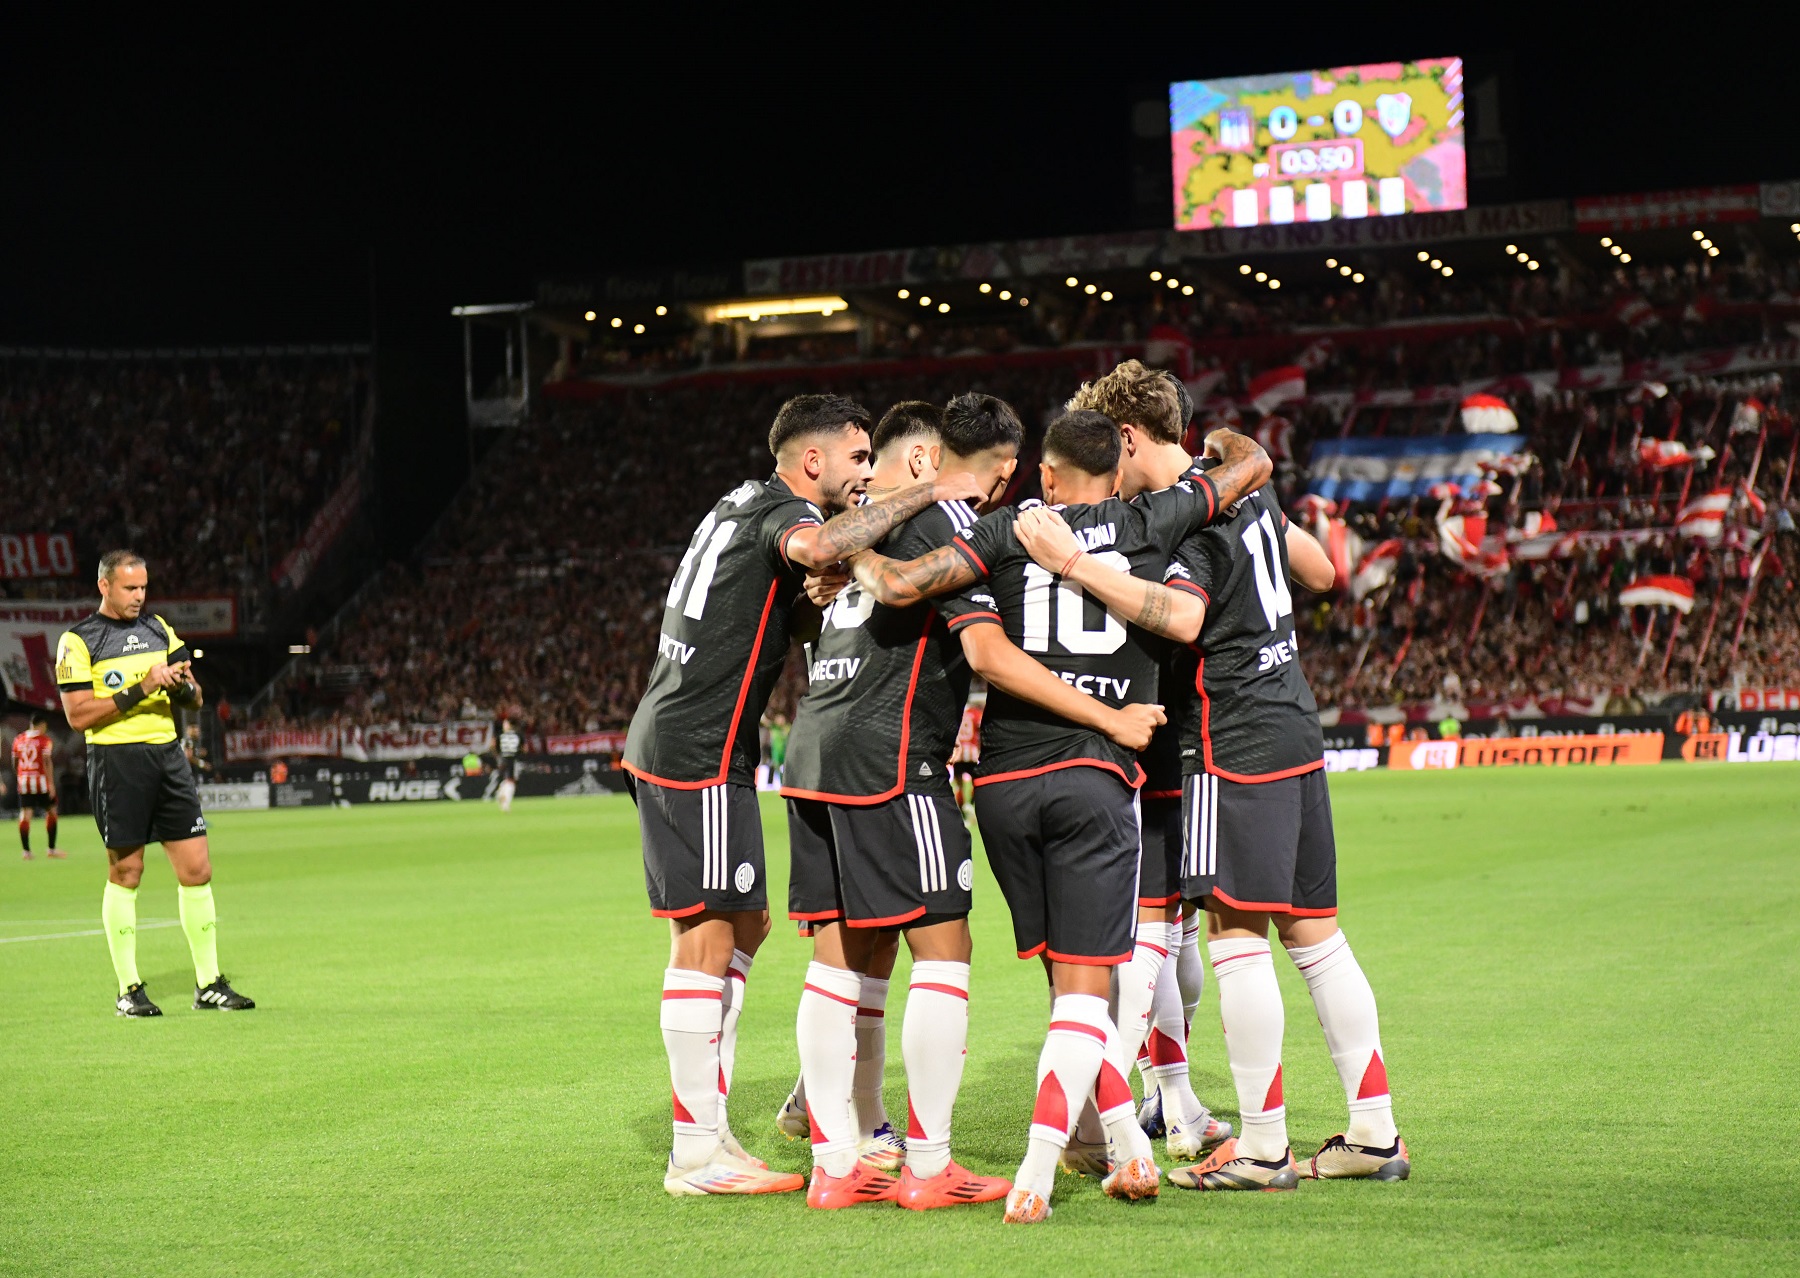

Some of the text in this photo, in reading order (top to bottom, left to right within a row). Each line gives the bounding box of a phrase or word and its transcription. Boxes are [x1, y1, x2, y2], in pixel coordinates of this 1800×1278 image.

[1269, 105, 1297, 141] 0
[1333, 99, 1363, 135] 0
[1280, 146, 1355, 175] 03:50
[1371, 209, 1467, 241] OLVIDA
[1241, 508, 1292, 632] 11
[1023, 550, 1132, 654] 10
